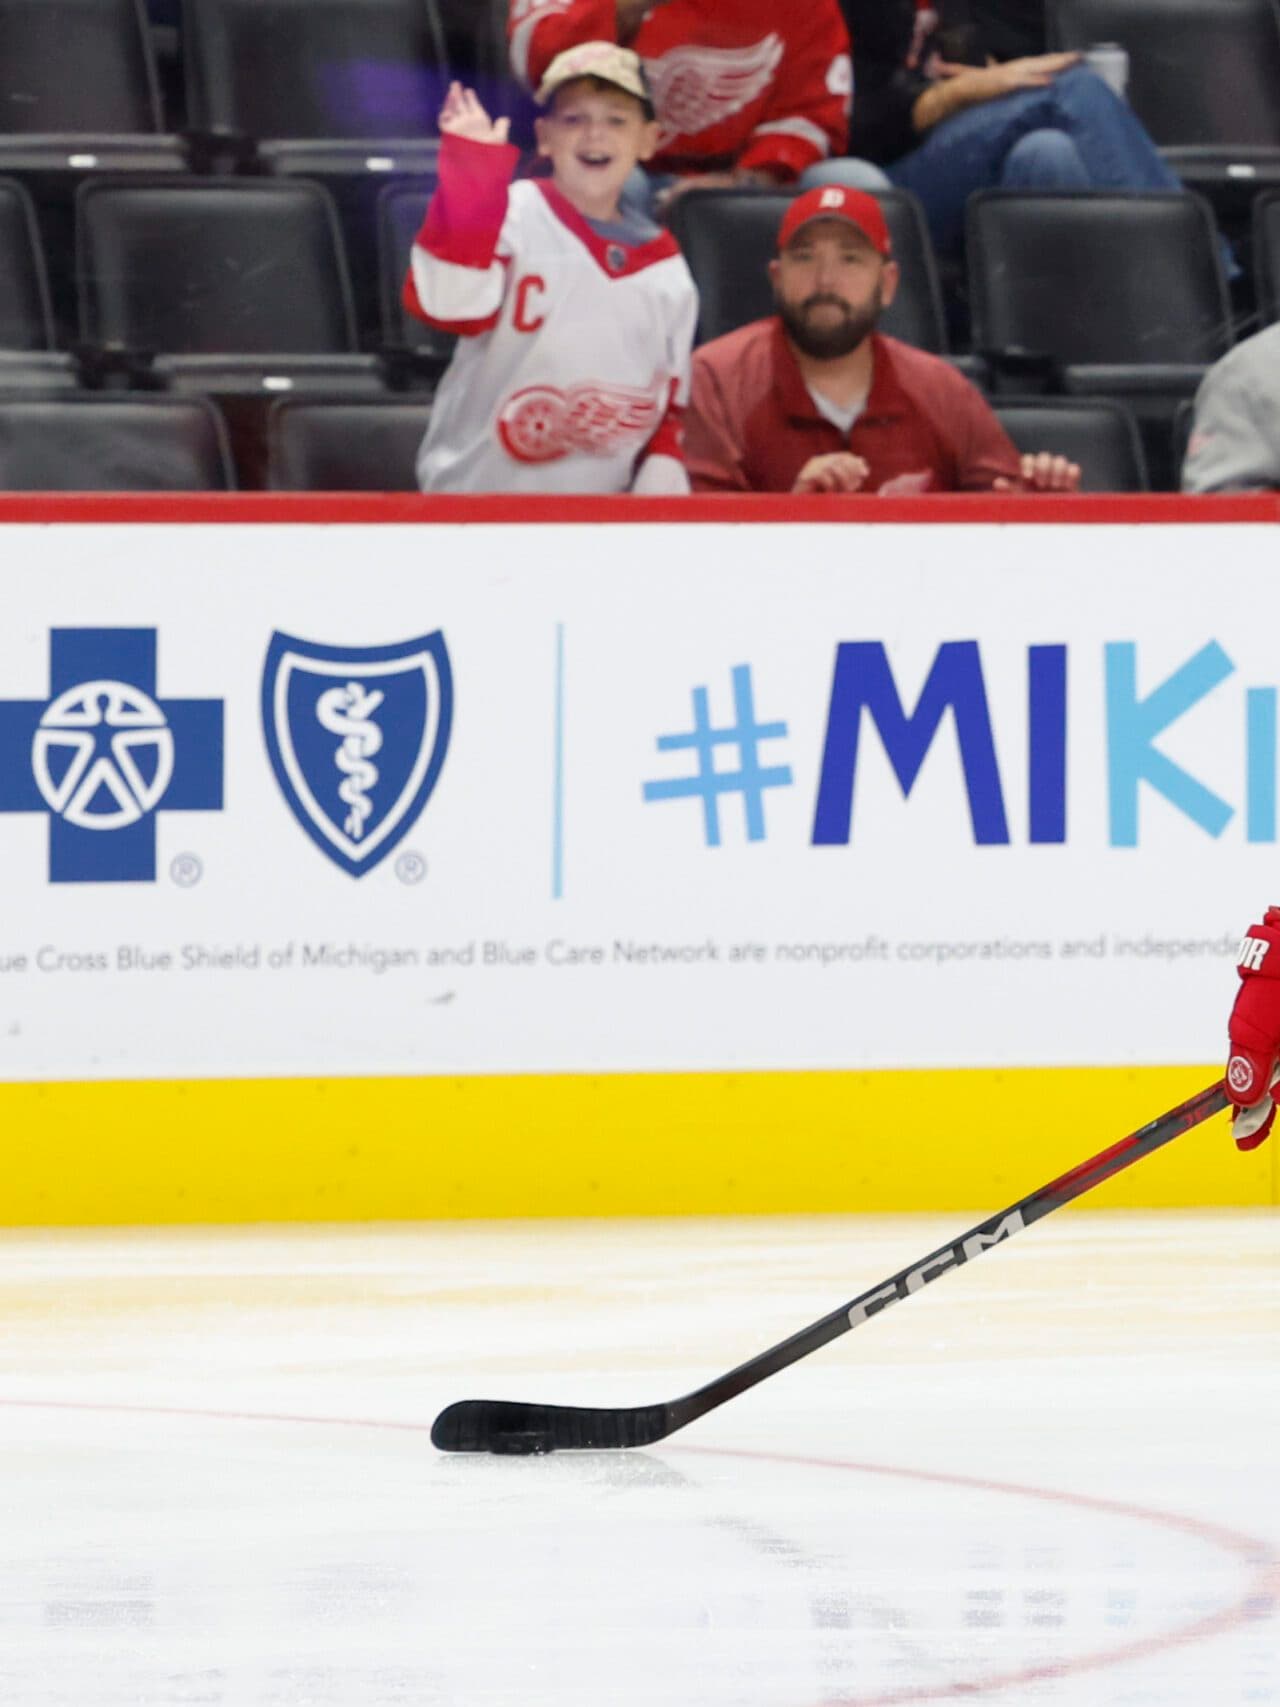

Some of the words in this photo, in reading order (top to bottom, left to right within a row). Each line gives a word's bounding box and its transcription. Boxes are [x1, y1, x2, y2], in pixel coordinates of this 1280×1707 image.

[514, 274, 545, 333] C
[36, 945, 108, 972] Cross
[117, 945, 173, 971] Blue
[180, 944, 259, 970] Shield
[267, 942, 295, 968] of
[302, 944, 420, 974] Michigan
[427, 942, 475, 966] and
[482, 941, 537, 965] Blue
[545, 940, 605, 966] Care
[613, 940, 718, 964] Network
[728, 943, 766, 963] are
[775, 936, 889, 967] nonprofit
[896, 934, 1050, 967] corporations
[1059, 933, 1106, 959] and
[848, 1209, 1024, 1329] CCM
